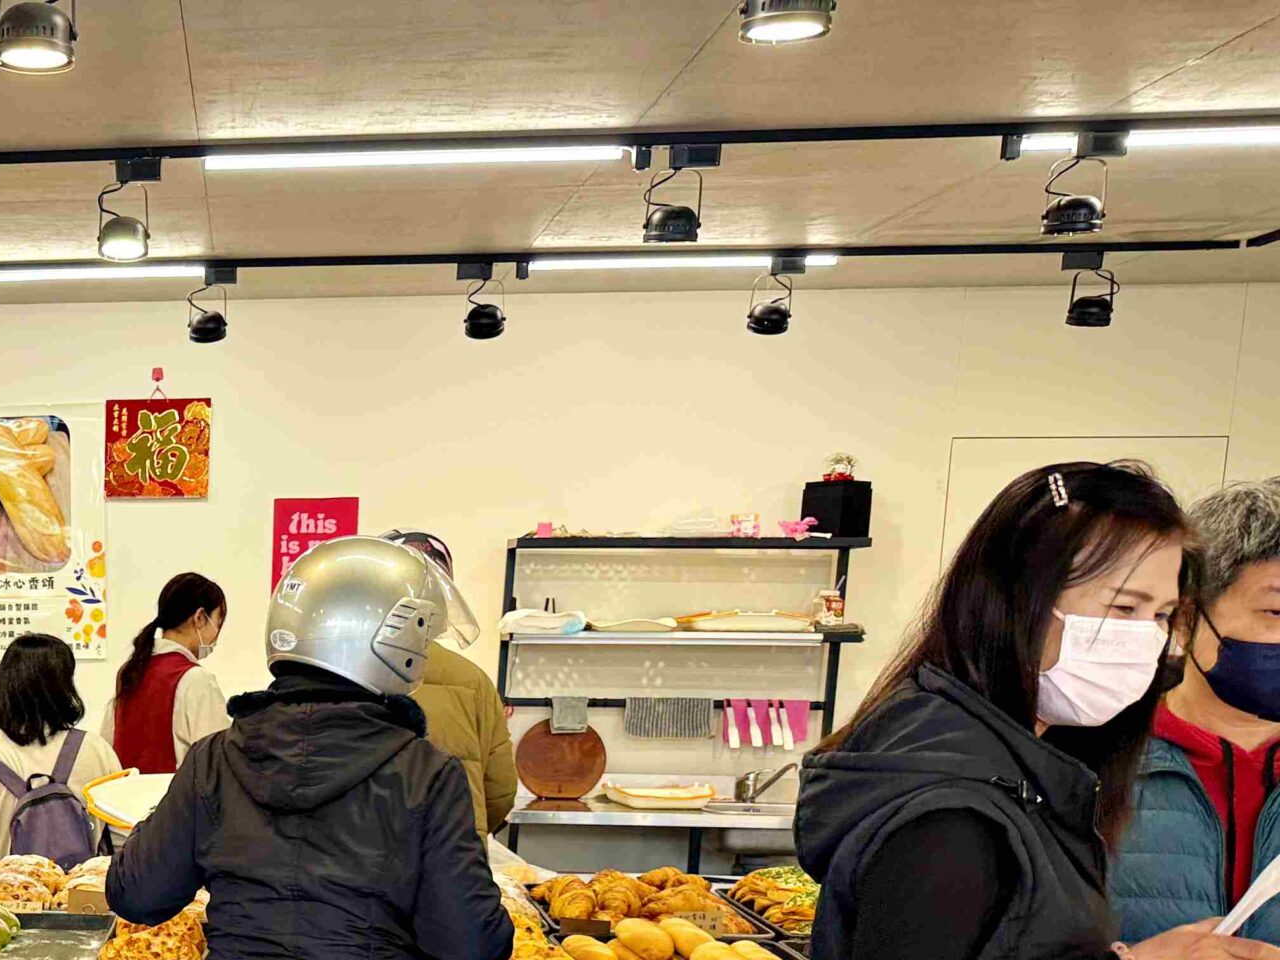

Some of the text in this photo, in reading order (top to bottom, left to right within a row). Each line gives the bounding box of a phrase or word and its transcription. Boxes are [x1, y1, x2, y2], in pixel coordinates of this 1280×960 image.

[124, 409, 190, 485] 福
[288, 512, 337, 534] this
[280, 535, 300, 554] is
